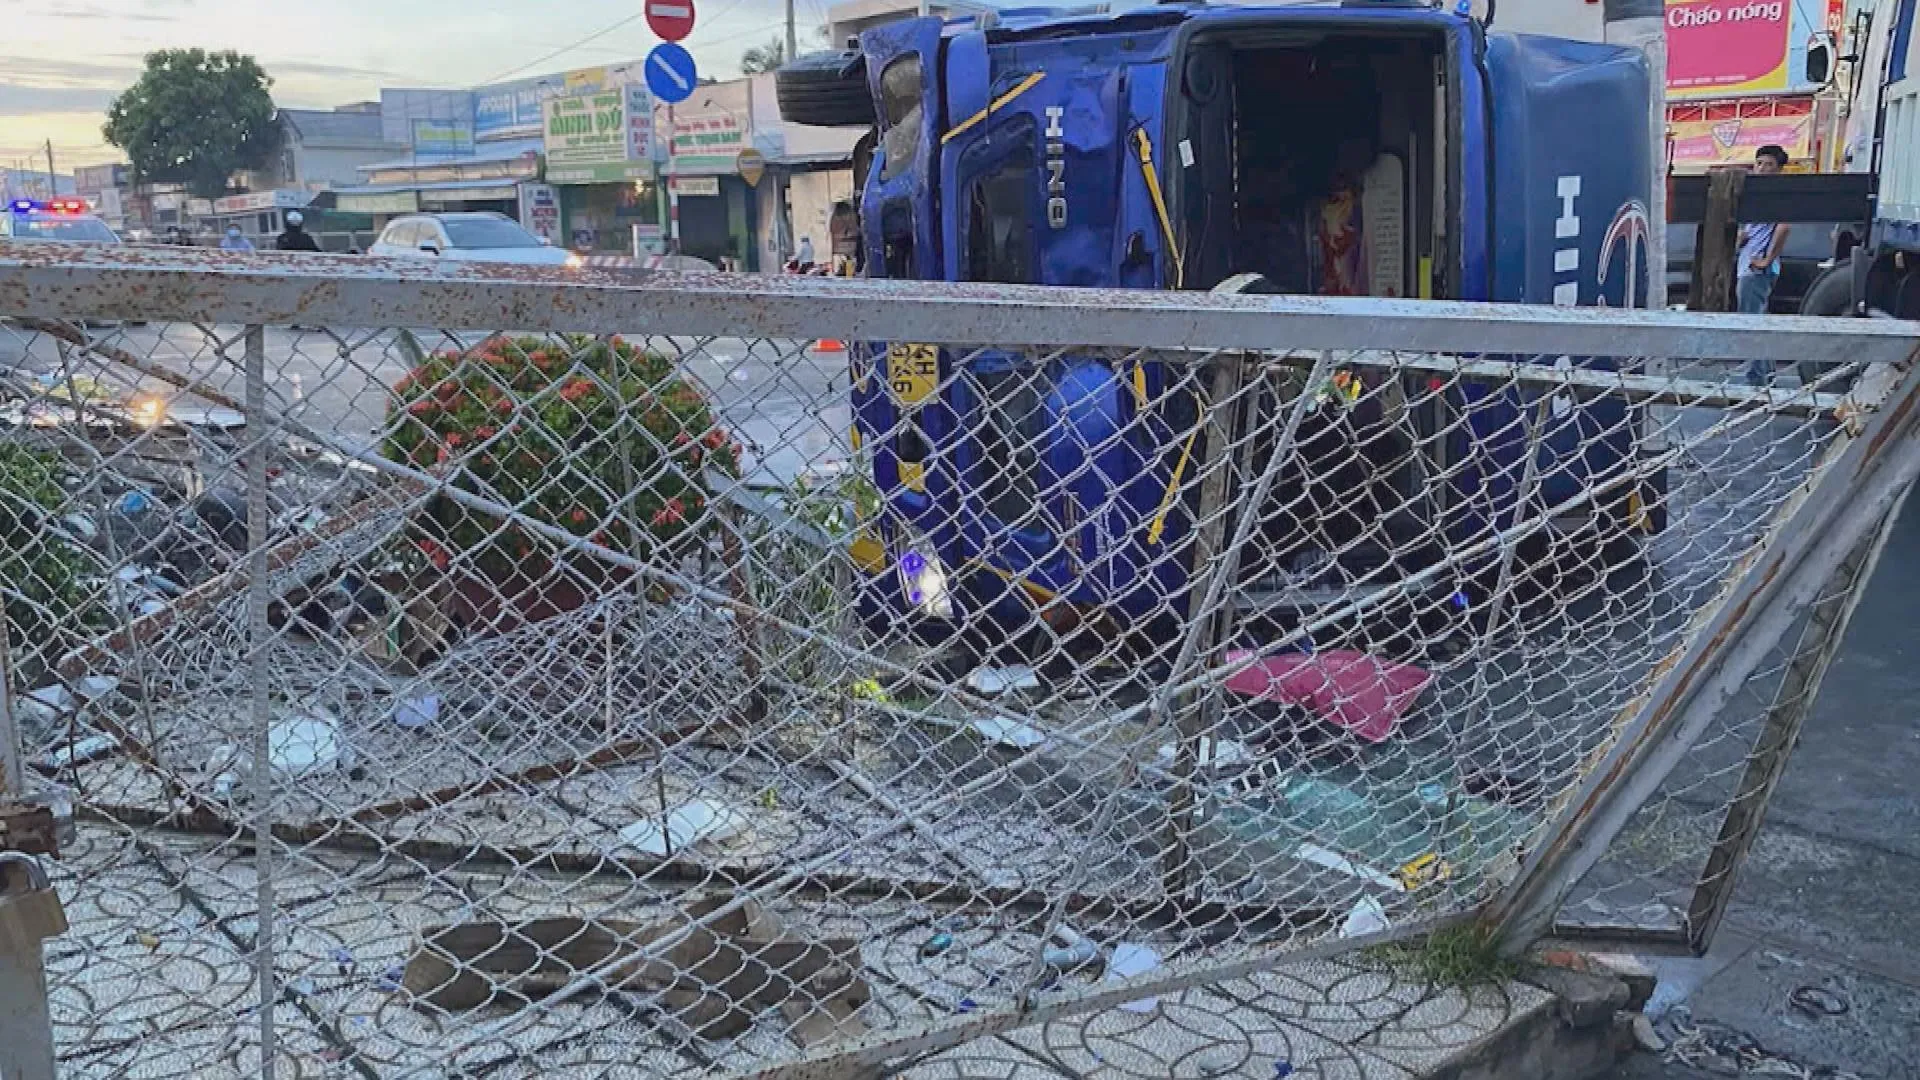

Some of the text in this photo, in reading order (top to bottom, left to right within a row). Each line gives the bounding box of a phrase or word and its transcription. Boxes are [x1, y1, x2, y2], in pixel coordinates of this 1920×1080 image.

[1668, 1, 1782, 28] Cháo nóng
[550, 107, 622, 136] MINH ĐỨ
[1045, 107, 1068, 228] HINO
